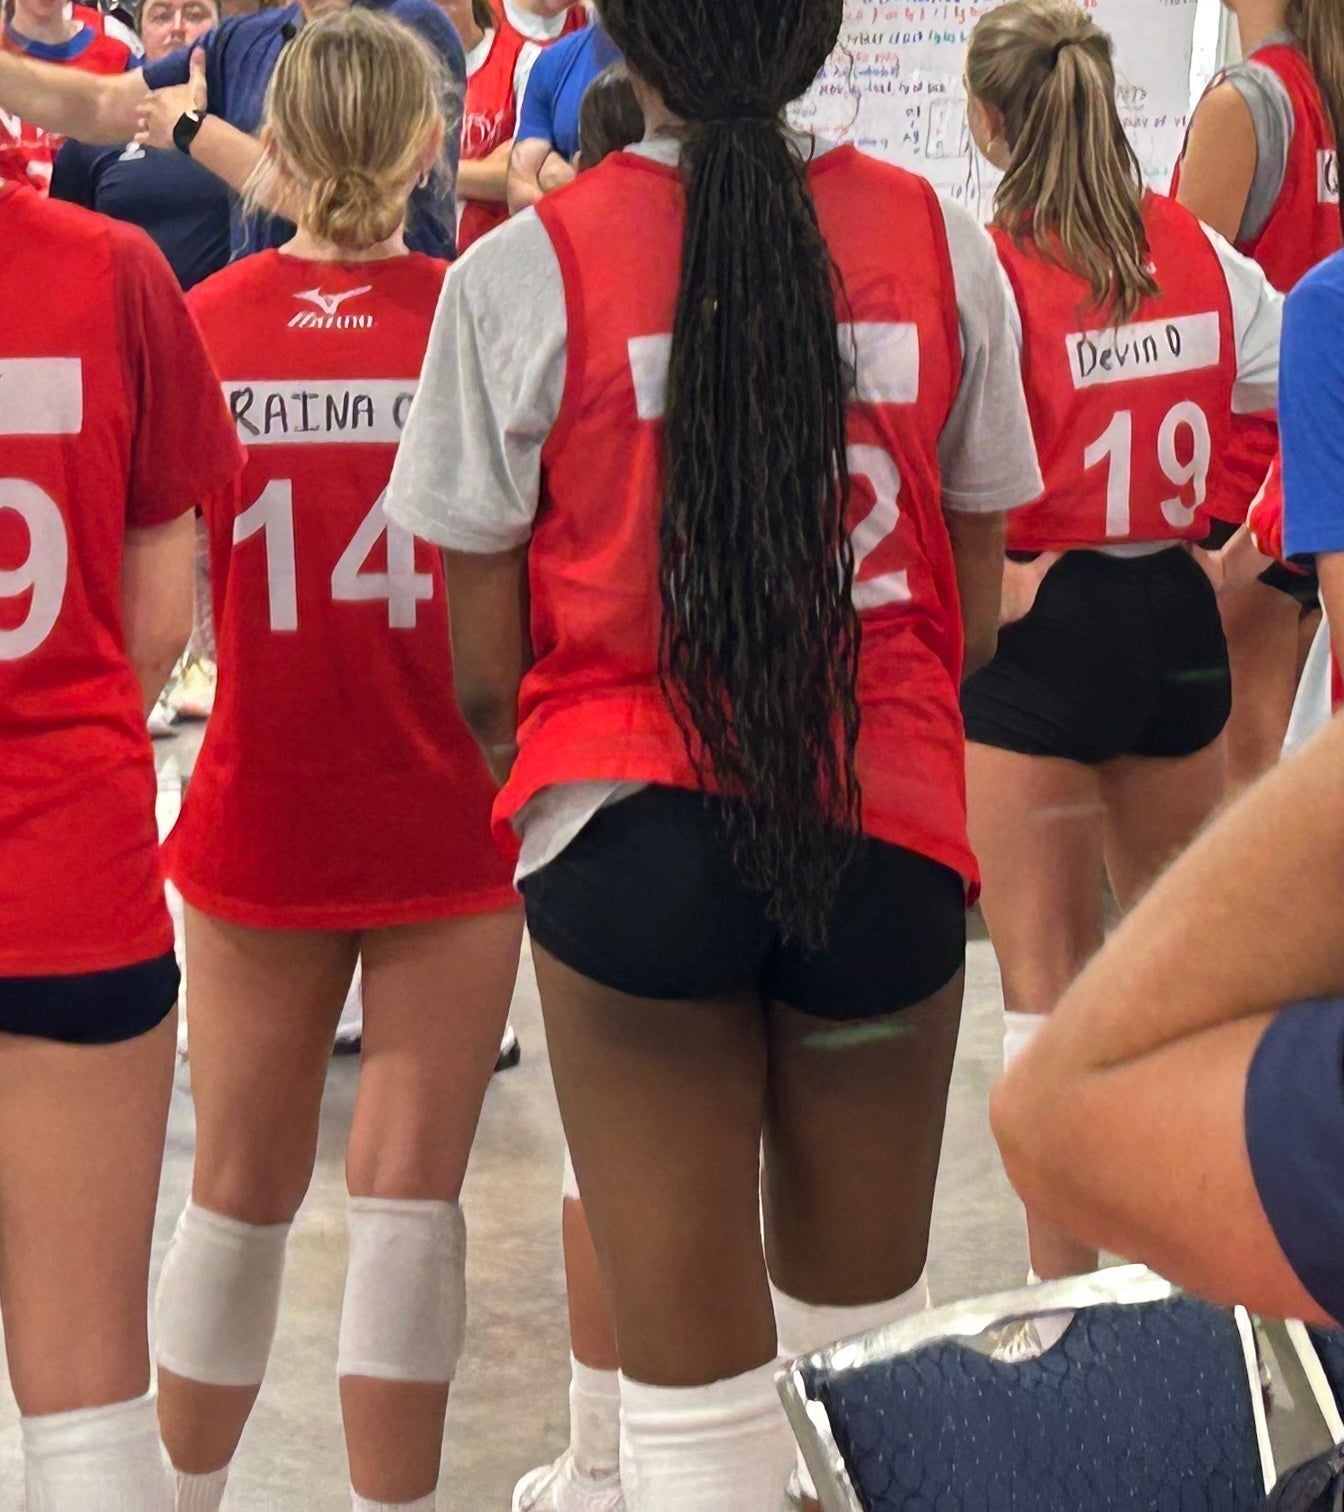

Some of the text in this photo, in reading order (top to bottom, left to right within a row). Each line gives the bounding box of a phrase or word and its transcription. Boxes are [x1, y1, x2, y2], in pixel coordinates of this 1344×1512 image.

[229, 386, 375, 437] RAINA
[1083, 400, 1212, 537] 19
[232, 478, 434, 632] 14
